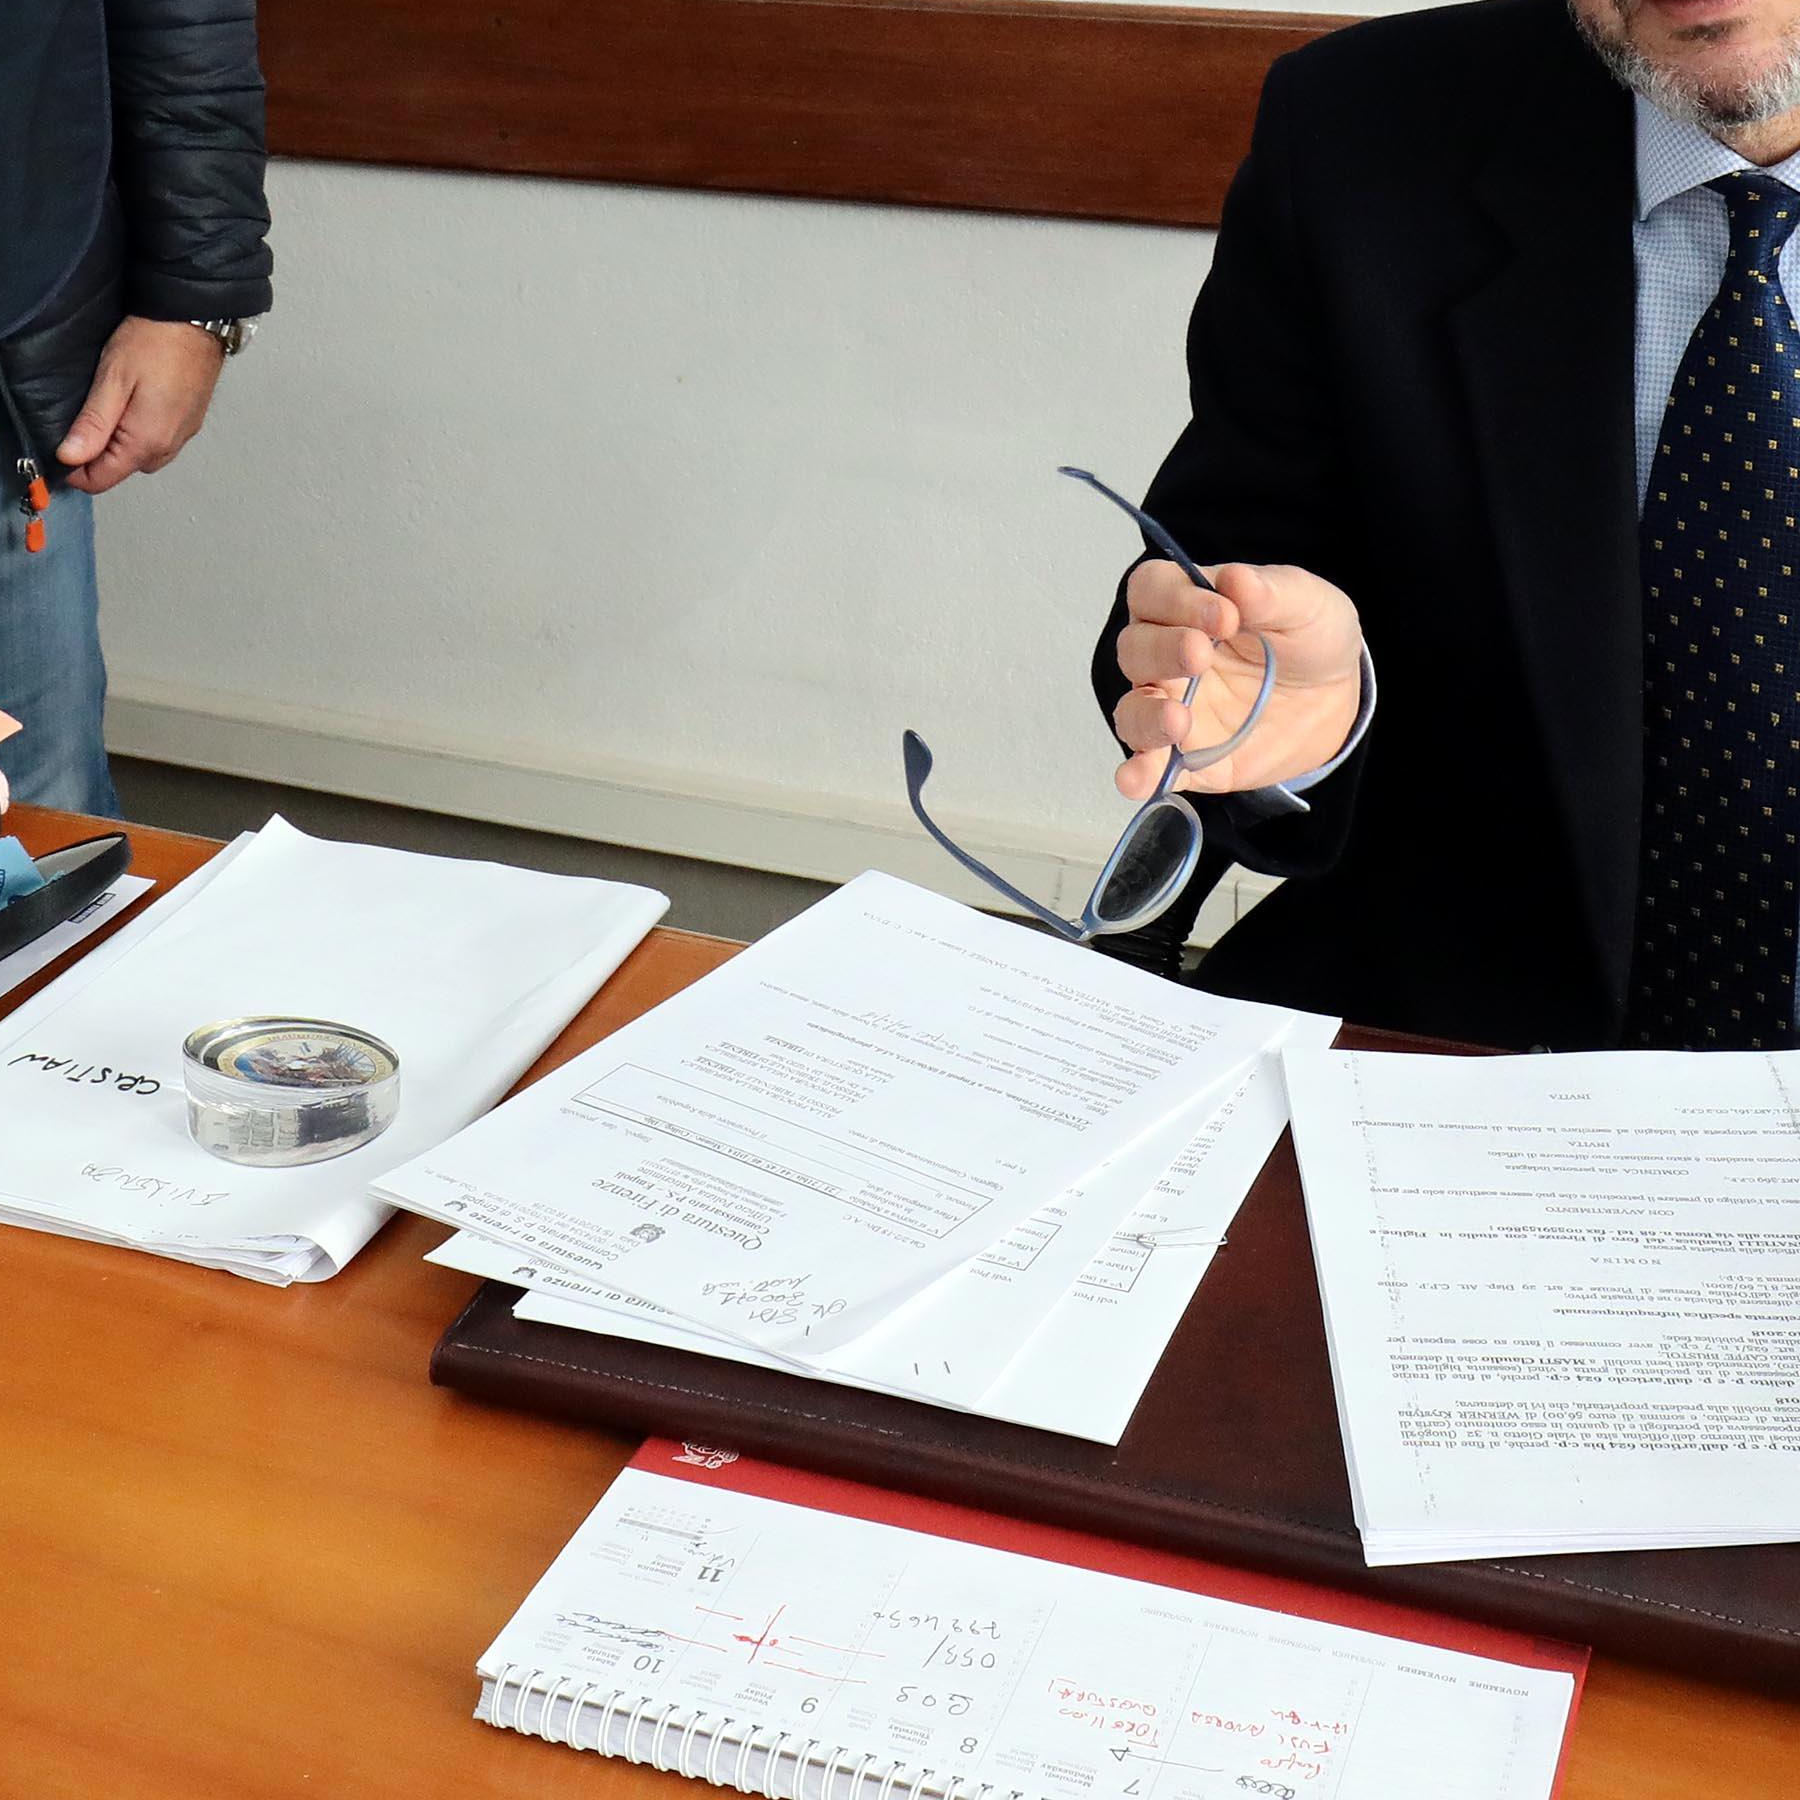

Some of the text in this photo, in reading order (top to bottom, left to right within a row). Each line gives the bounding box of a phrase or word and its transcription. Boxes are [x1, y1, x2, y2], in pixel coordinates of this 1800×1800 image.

[591, 1178, 763, 1251] Questura di Firenze
[688, 1197, 771, 1235] Commissariato
[1461, 1440, 1485, 1448] fine
[1583, 1442, 1605, 1450] bis
[1608, 1442, 1636, 1450] 624
[697, 1565, 725, 1583] 11
[633, 1655, 665, 1675] 10
[1397, 1665, 1529, 1697] NOVEMBRE NOVEMBER
[801, 1697, 819, 1714] 9
[960, 1737, 978, 1754] 8
[1123, 1778, 1141, 1796] 7
